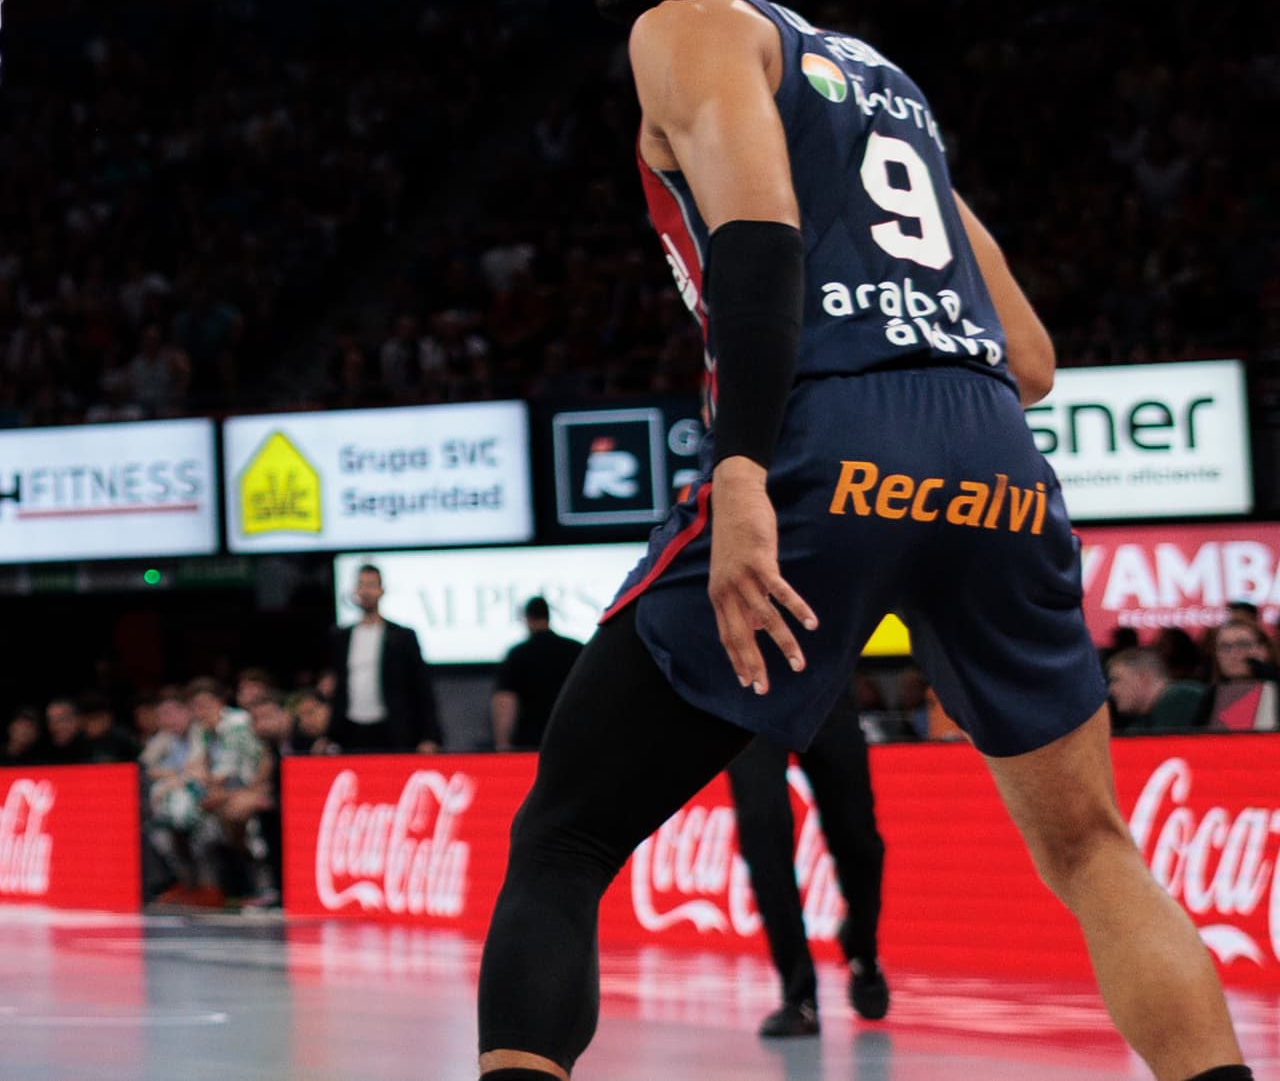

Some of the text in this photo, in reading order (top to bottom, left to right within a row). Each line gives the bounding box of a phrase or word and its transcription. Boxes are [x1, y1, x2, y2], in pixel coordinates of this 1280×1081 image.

[860, 130, 953, 270] 9
[821, 278, 962, 324] araba
[339, 444, 428, 477] Grupo
[341, 482, 503, 521] Seguridad
[829, 460, 1048, 535] Recalvi
